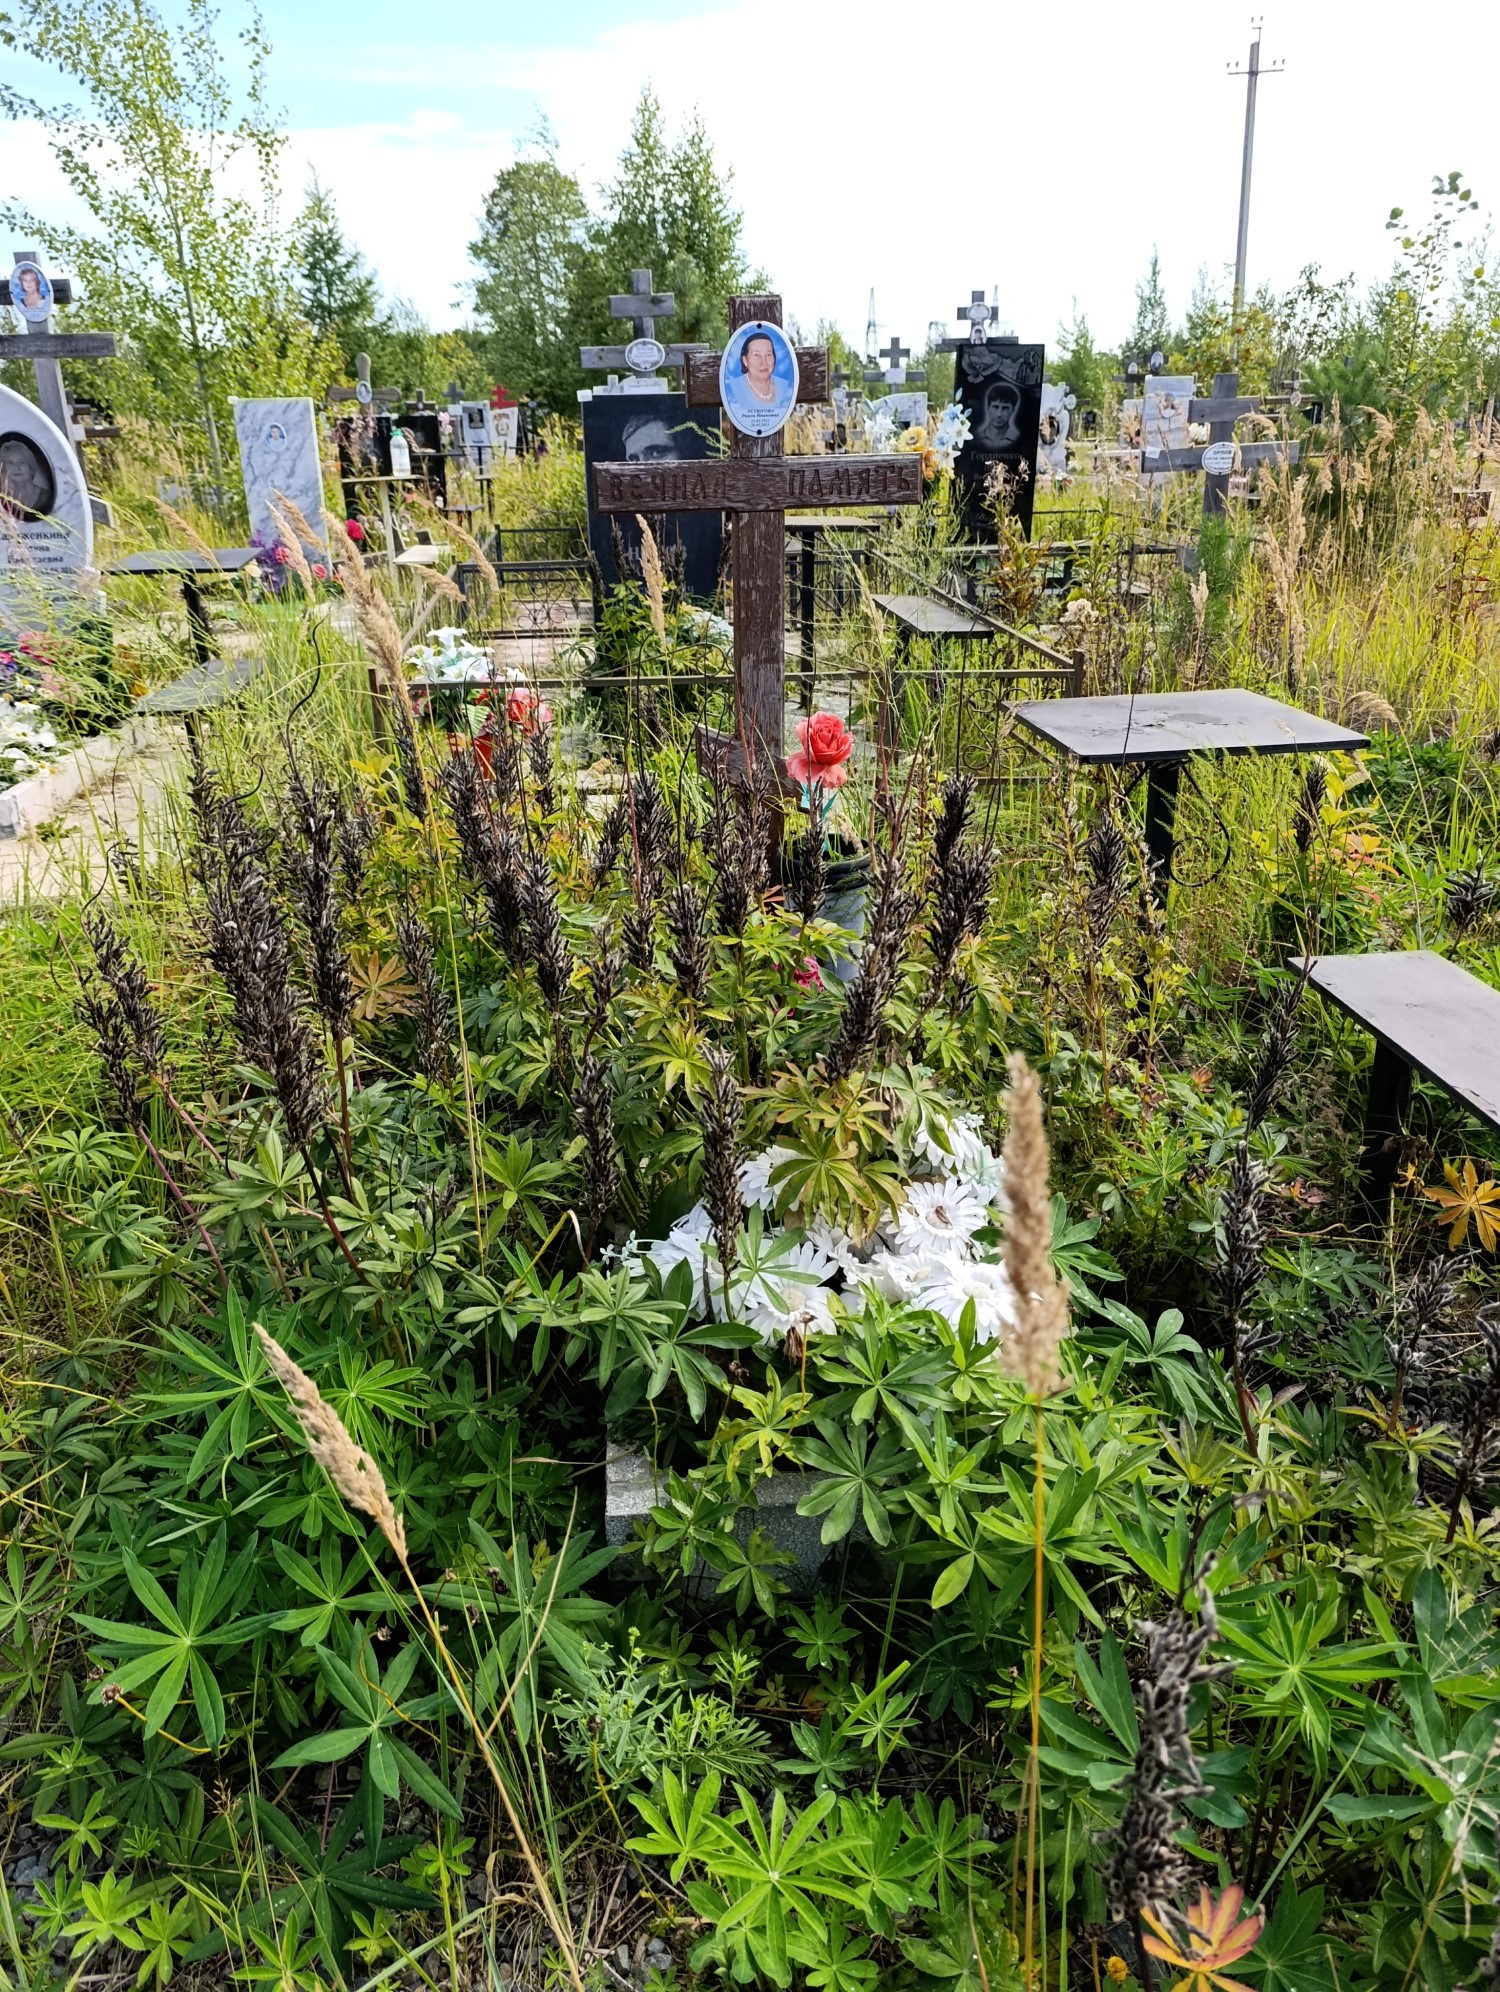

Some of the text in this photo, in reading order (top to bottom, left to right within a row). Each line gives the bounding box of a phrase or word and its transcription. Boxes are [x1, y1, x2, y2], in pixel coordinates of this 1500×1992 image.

[970, 451, 1020, 462] Гордиенко
[609, 465, 911, 502] ВЕЧНАЯ ПАМЯТЬ
